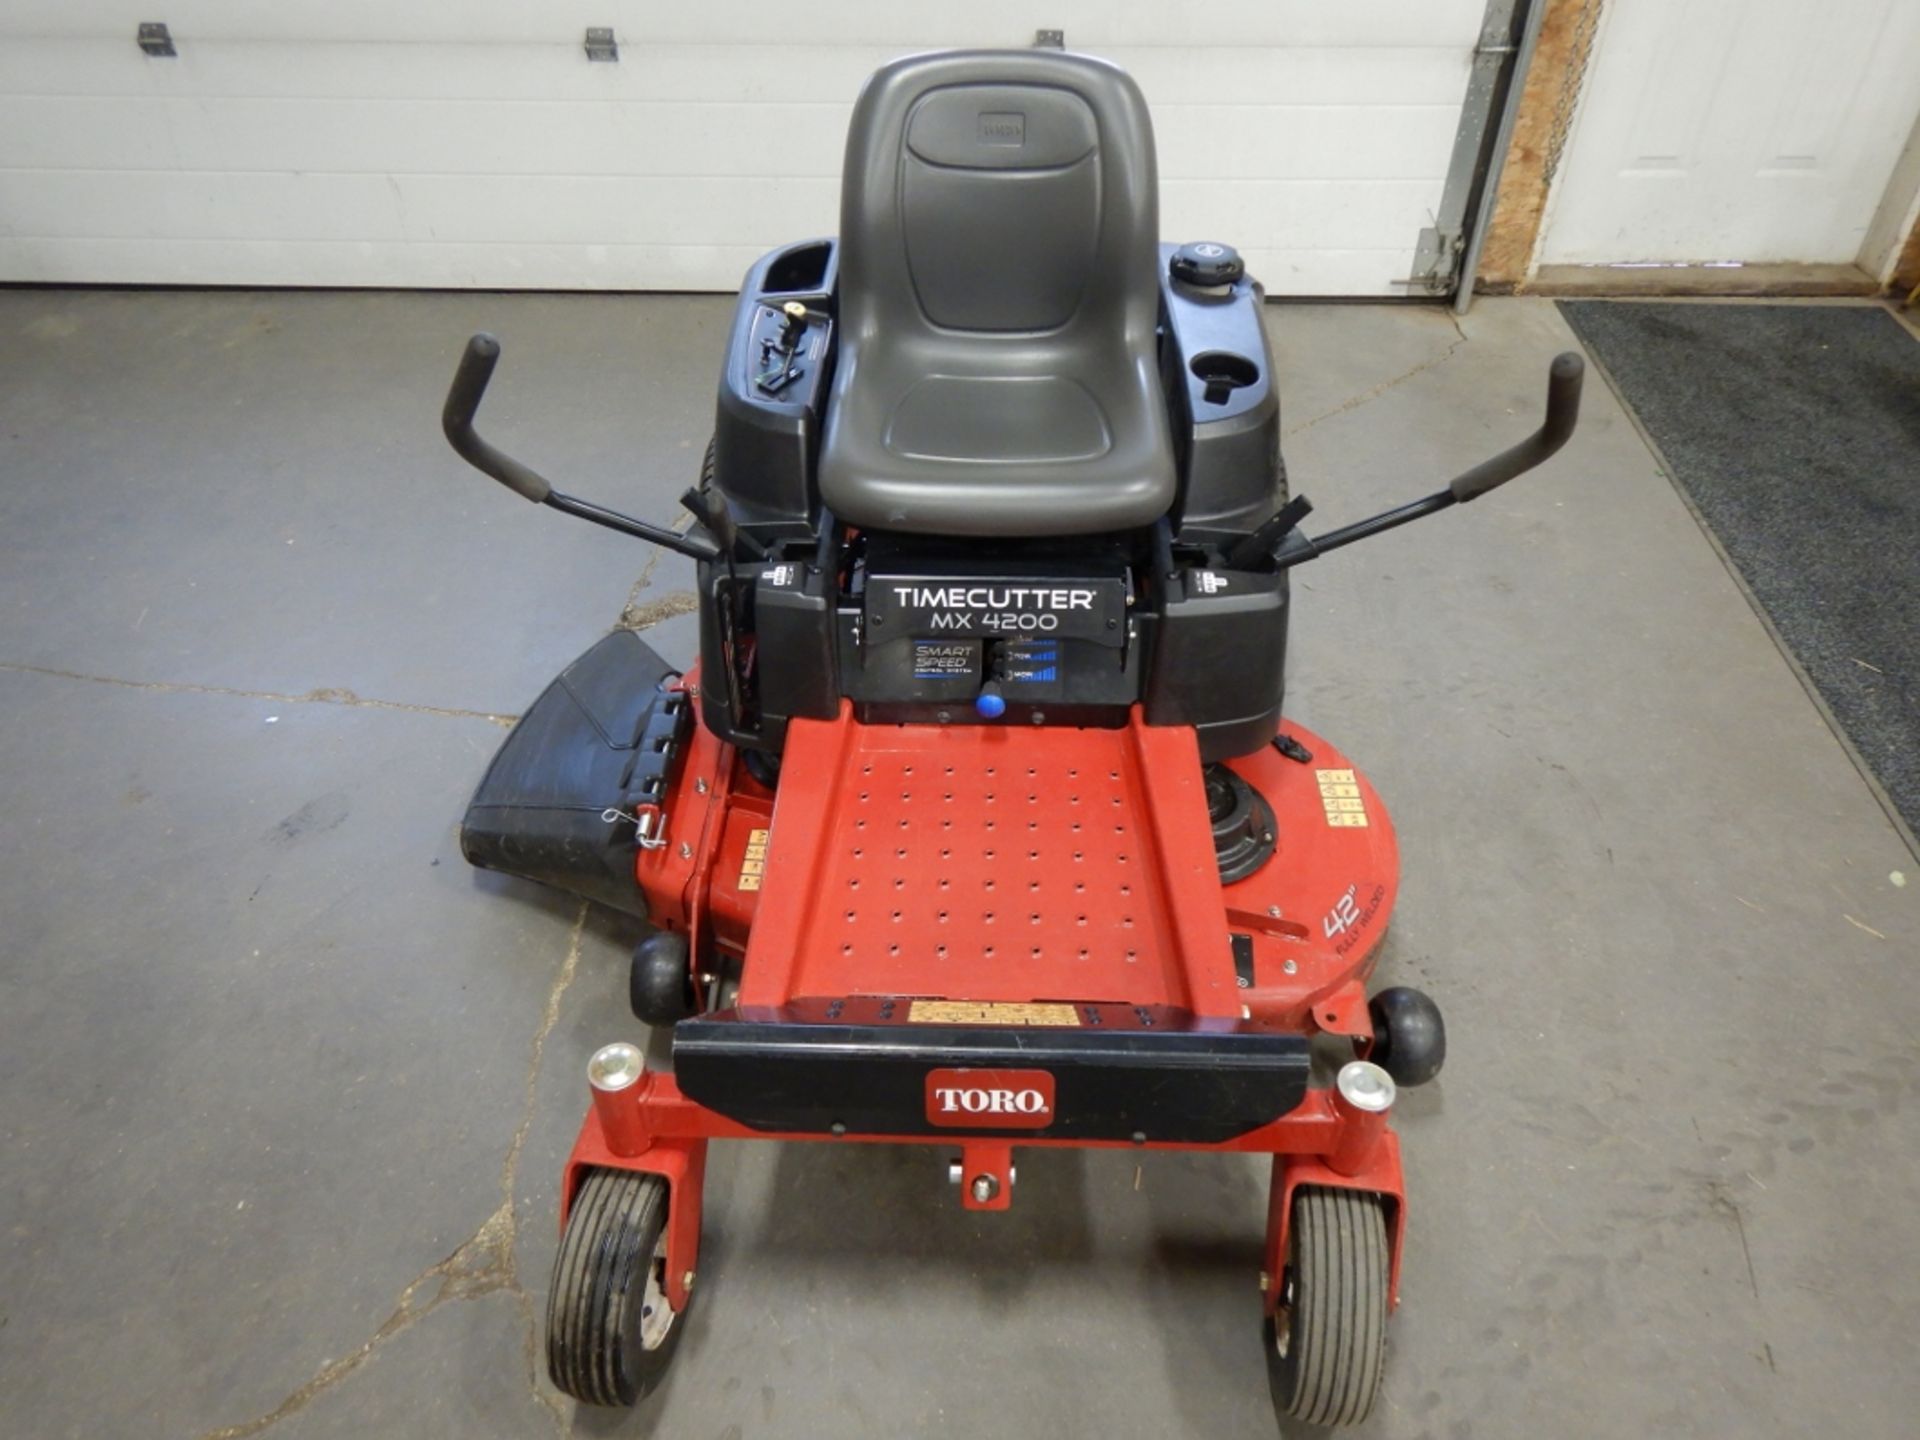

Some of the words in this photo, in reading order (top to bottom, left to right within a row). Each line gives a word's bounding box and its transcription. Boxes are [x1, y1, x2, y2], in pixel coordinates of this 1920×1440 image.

[930, 613, 972, 629] MX
[981, 613, 1058, 630] 4200
[916, 646, 973, 656] SMART
[916, 657, 966, 667] SPEED
[936, 1089, 1045, 1113] TORO
